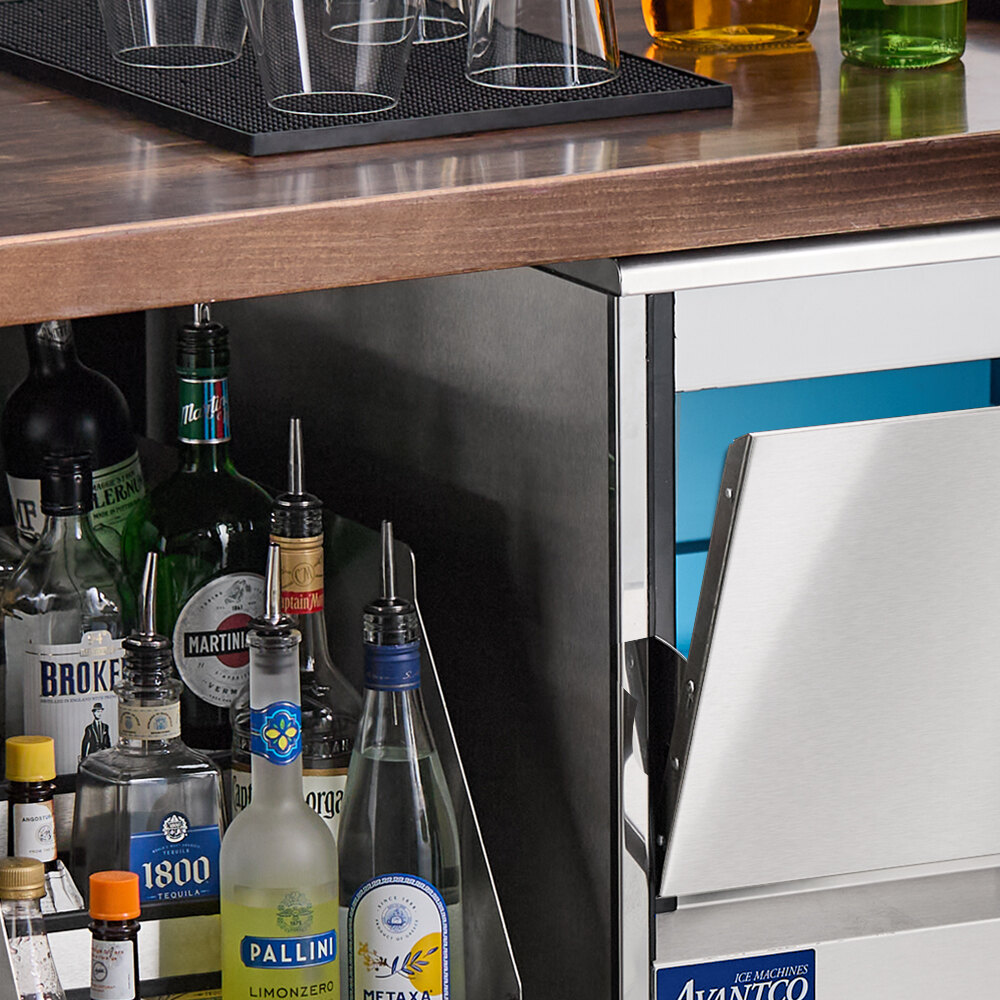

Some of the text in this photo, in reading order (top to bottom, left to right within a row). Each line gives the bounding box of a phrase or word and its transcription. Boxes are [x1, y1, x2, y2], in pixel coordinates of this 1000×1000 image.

[188, 630, 246, 654] MARTINI
[208, 682, 239, 694] VERM
[303, 790, 344, 818] orga
[141, 856, 210, 889] 1800
[157, 889, 201, 900] TEQUILA
[250, 936, 333, 963] PALLINI
[734, 964, 808, 984] ICE MACHINES
[249, 980, 334, 999] LIMONZERO
